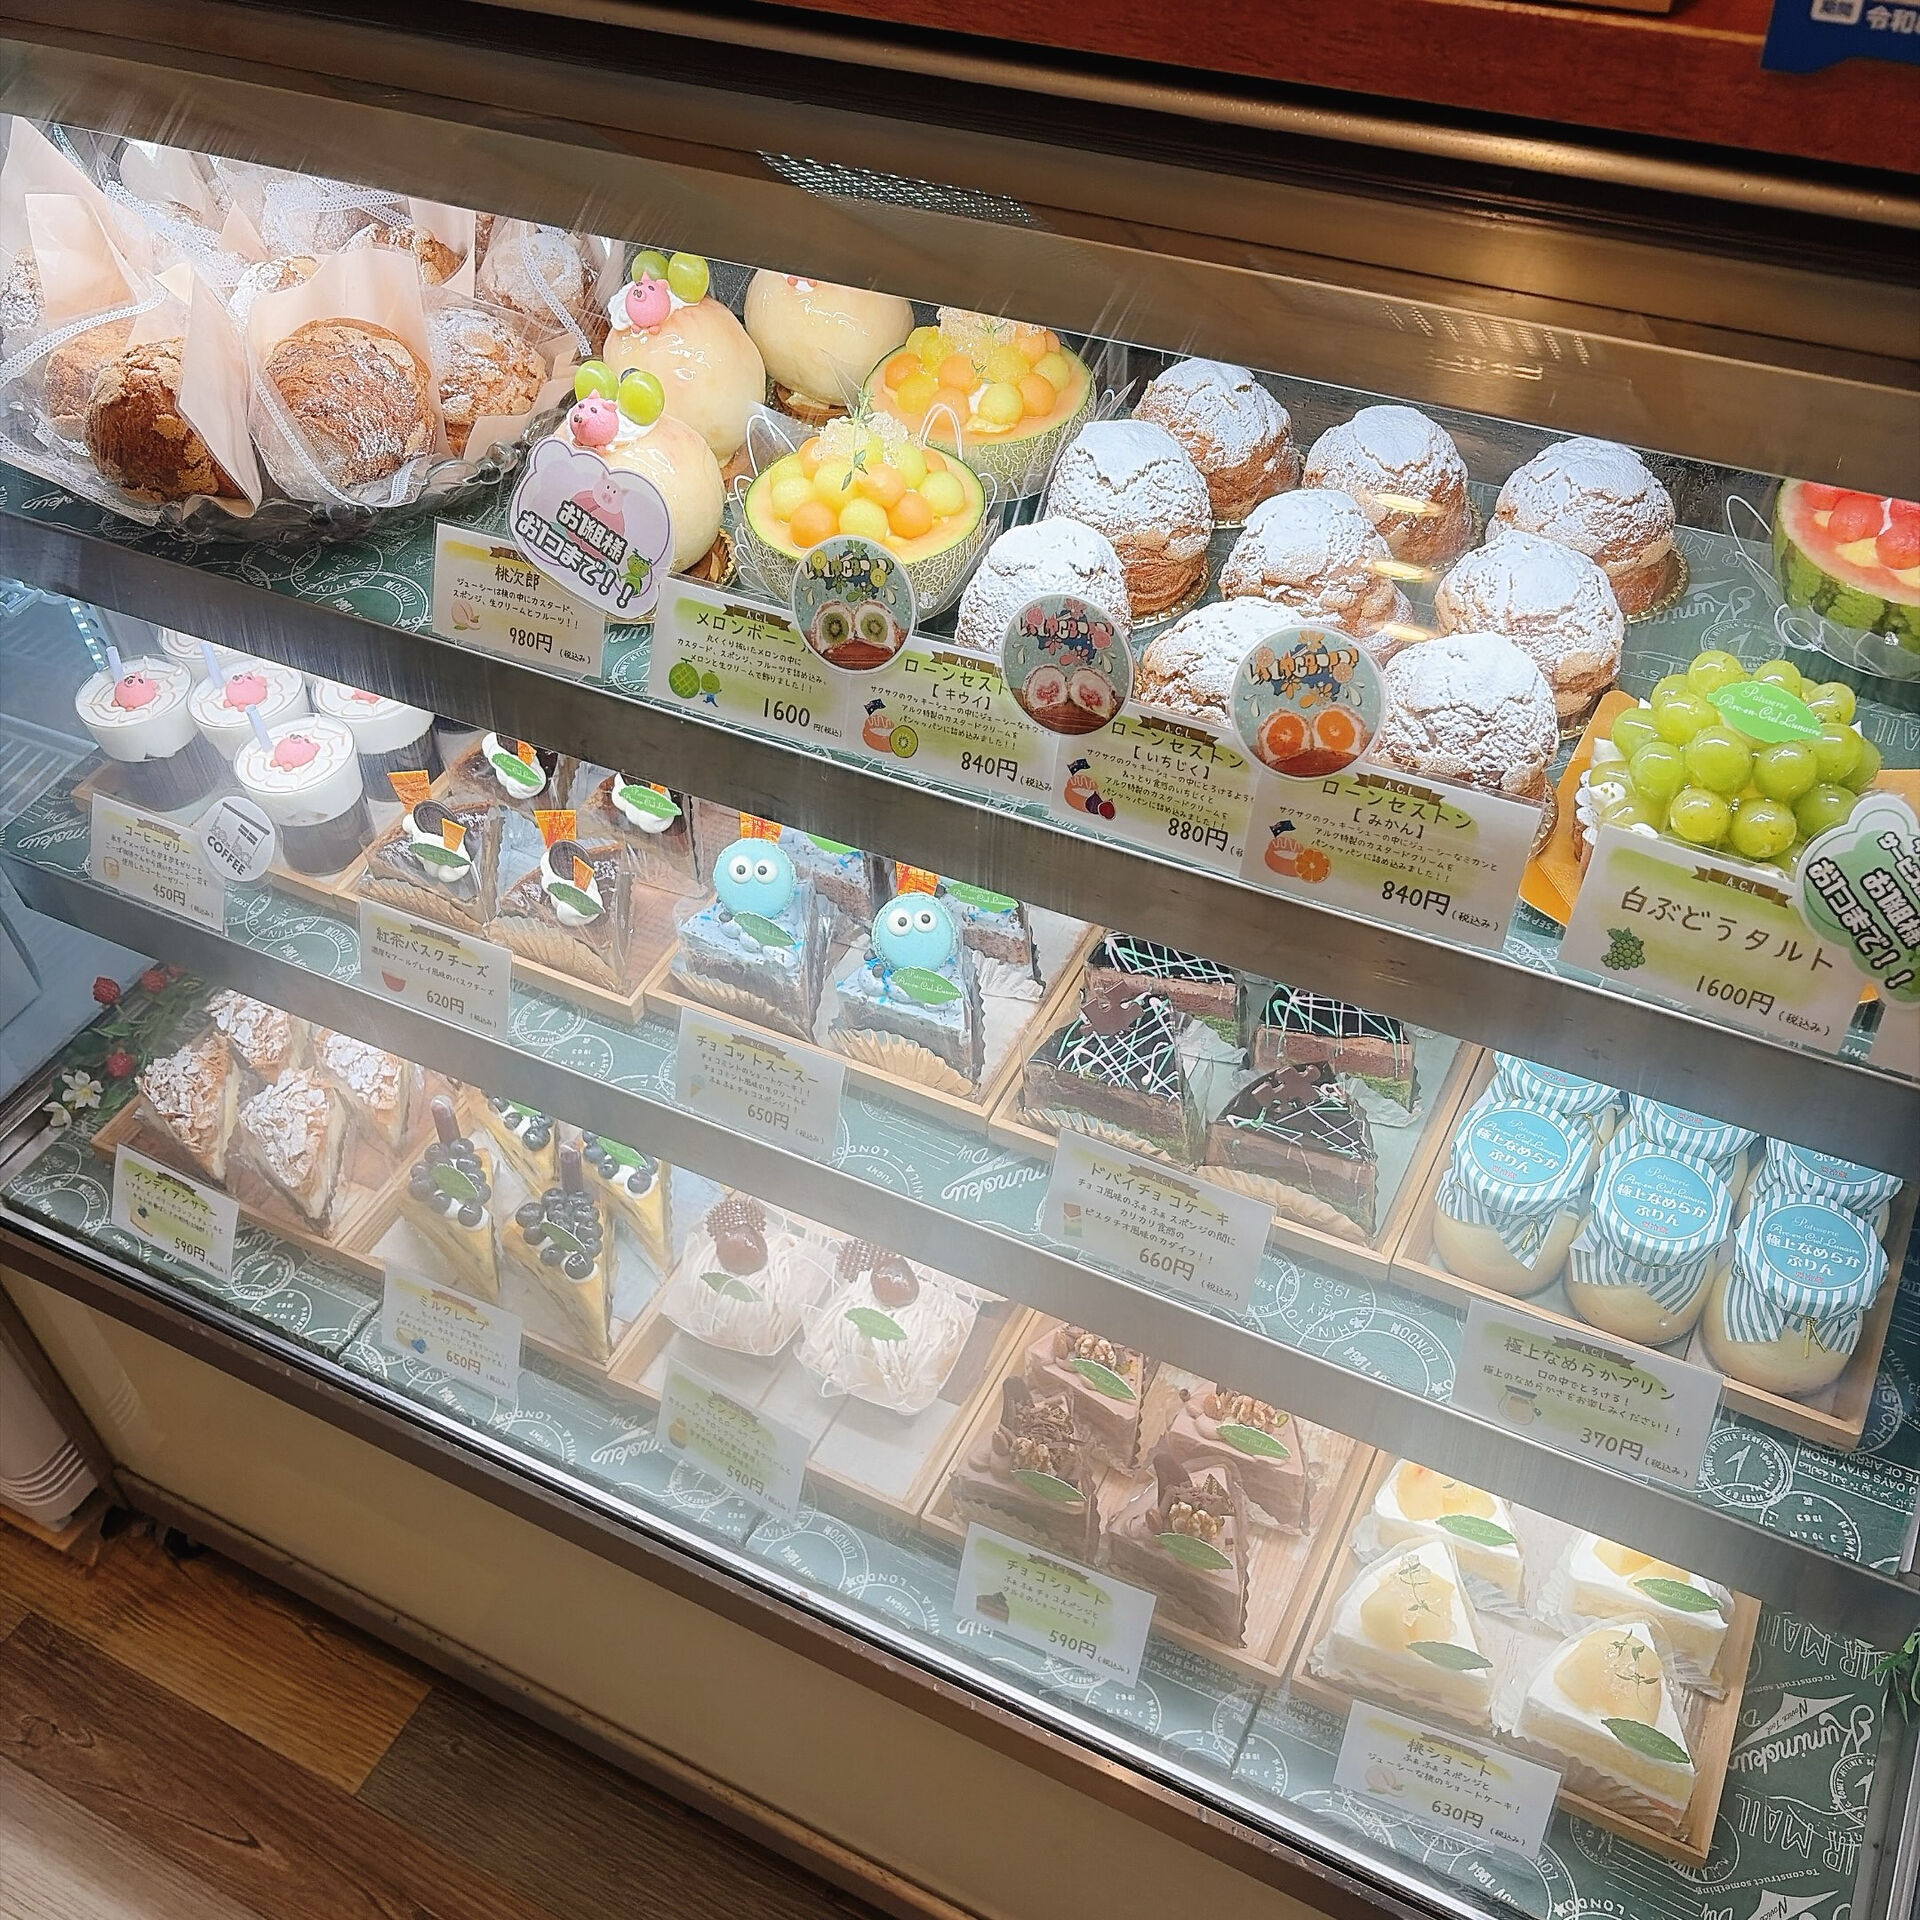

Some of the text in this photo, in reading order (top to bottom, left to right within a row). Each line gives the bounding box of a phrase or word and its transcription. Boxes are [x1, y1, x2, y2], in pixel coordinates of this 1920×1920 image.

[1866, 5, 1920, 34] 令和
[495, 564, 540, 592] 桃次郎
[509, 626, 553, 654] 980円
[955, 659, 981, 671] A.C.L
[764, 698, 810, 727] 1600
[1112, 721, 1244, 769] ローンセストン
[1164, 723, 1192, 738] A.C.L
[961, 751, 1018, 782] 840円
[1134, 745, 1211, 780] 【いちじく】
[1322, 780, 1473, 830] ローンセストン
[1384, 780, 1415, 797] A.C.L
[125, 825, 191, 855] コーヒーゼリー
[1168, 818, 1228, 852] 880円
[1353, 807, 1425, 840] 【みかん】
[207, 835, 246, 876] COFFEE
[153, 884, 186, 907] 450円
[1381, 880, 1451, 916] 840円
[1621, 884, 1834, 972] 白ぶどうタルト
[376, 926, 490, 978] 紅茶バスクチーズ
[427, 990, 464, 1015] 620円
[1695, 973, 1776, 1017] 1600円
[697, 1035, 820, 1084] チョコットスースー
[747, 1104, 789, 1131] 650円
[1475, 1127, 1559, 1170] 極上なめらか
[865, 1165, 893, 1184] FLIGHT
[134, 1172, 217, 1217] インディアンサマー
[1091, 1162, 1230, 1227] ドバイチョコケーキ
[1616, 1183, 1708, 1218] 極上なめらか
[1120, 1207, 1185, 1240] カリカリ食感の
[174, 1237, 206, 1262] 590円
[1139, 1247, 1196, 1282] 660円
[1765, 1233, 1861, 1269] 極上なめらか
[419, 1295, 489, 1330] ミルクレープ
[1390, 1322, 1439, 1363] LONDON
[446, 1350, 481, 1375] 650円
[1504, 1335, 1676, 1401] 極上なめらかプリン
[1580, 1427, 1643, 1461] 370円
[1799, 1447, 1837, 1468] FROM
[726, 1465, 765, 1496] 590円
[1838, 1461, 1870, 1480] STAY
[822, 1524, 859, 1560] LONDON
[1006, 1560, 1105, 1606] チョコショート
[1048, 1629, 1097, 1660] 590円
[1407, 1738, 1492, 1777] 桃ショート
[1431, 1800, 1484, 1830] 630円
[1736, 1792, 1815, 1860] MAIL
[1752, 1870, 1804, 1887] construct
